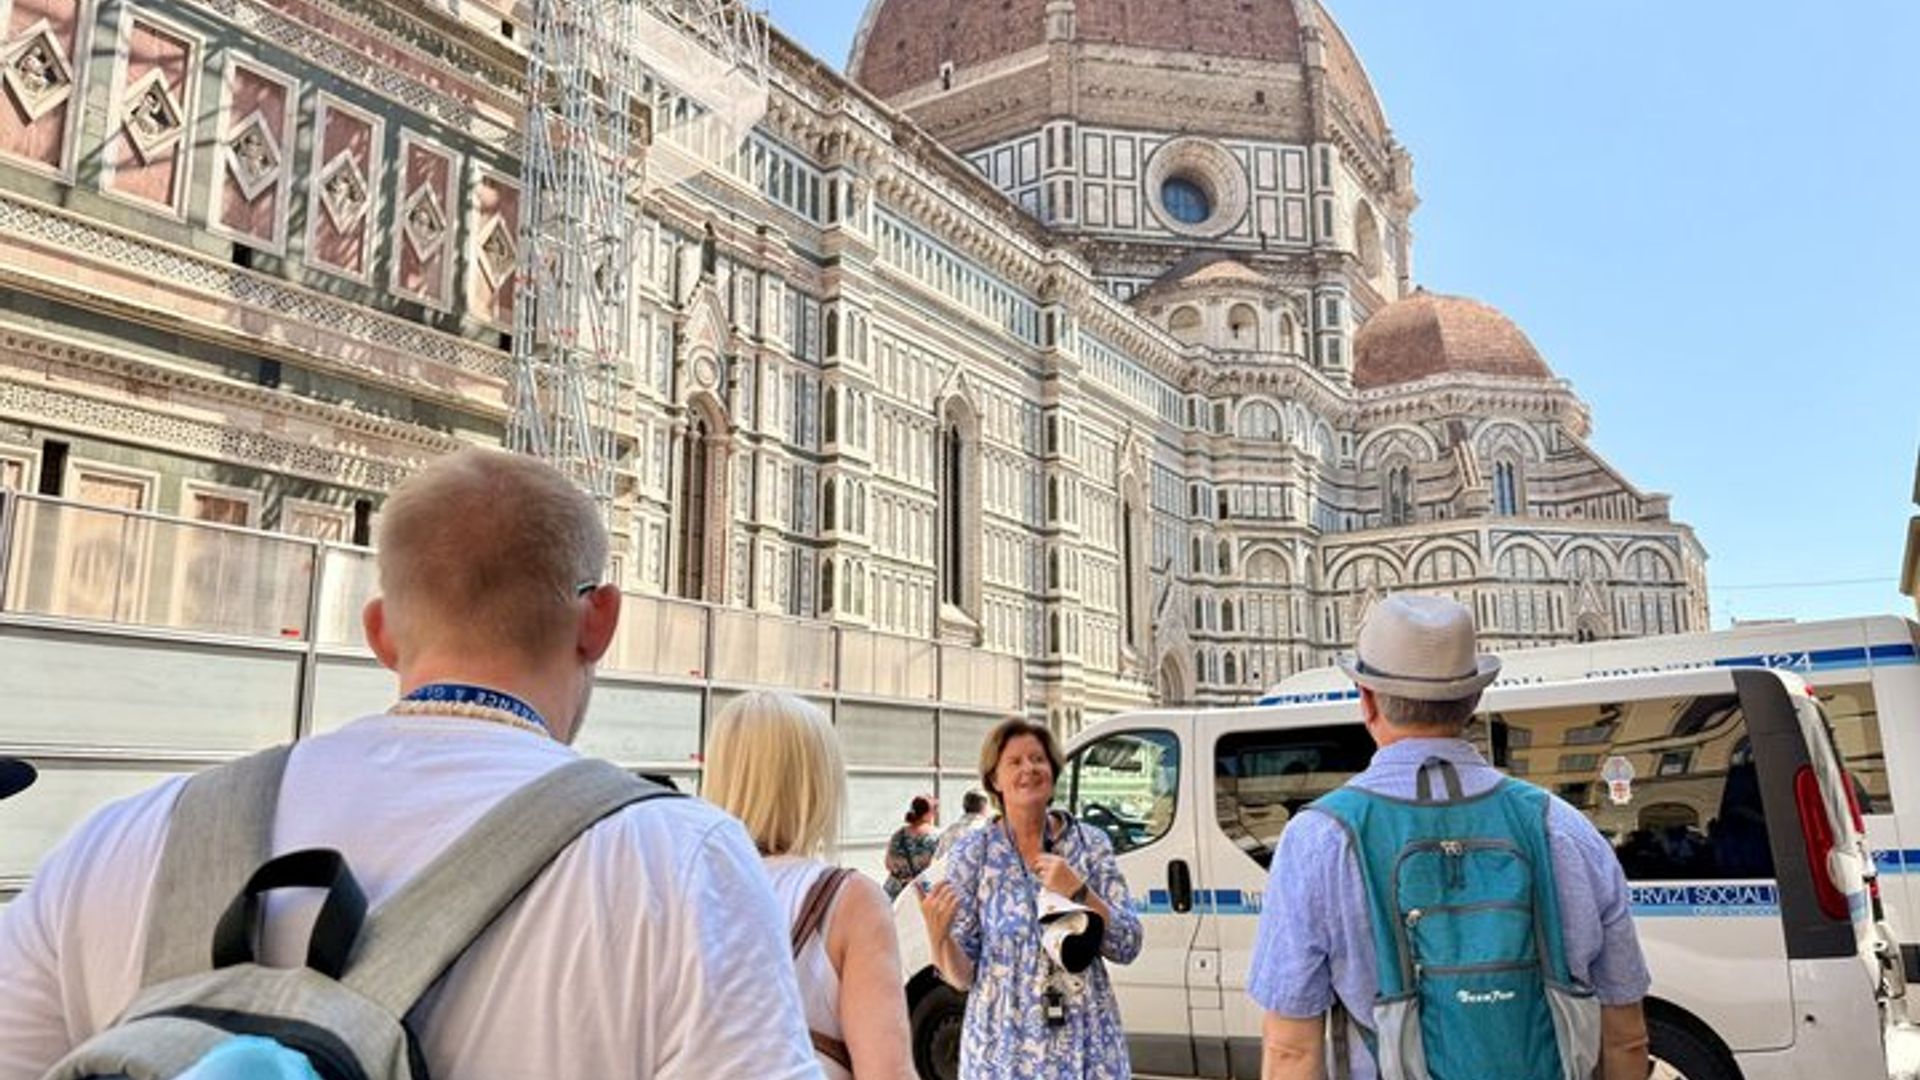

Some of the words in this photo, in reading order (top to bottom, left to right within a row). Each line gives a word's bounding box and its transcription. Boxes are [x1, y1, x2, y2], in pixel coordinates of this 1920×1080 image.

[1762, 651, 1812, 672] 124
[1626, 886, 1690, 905] ERVIZI
[1695, 885, 1775, 905] SOCIALI
